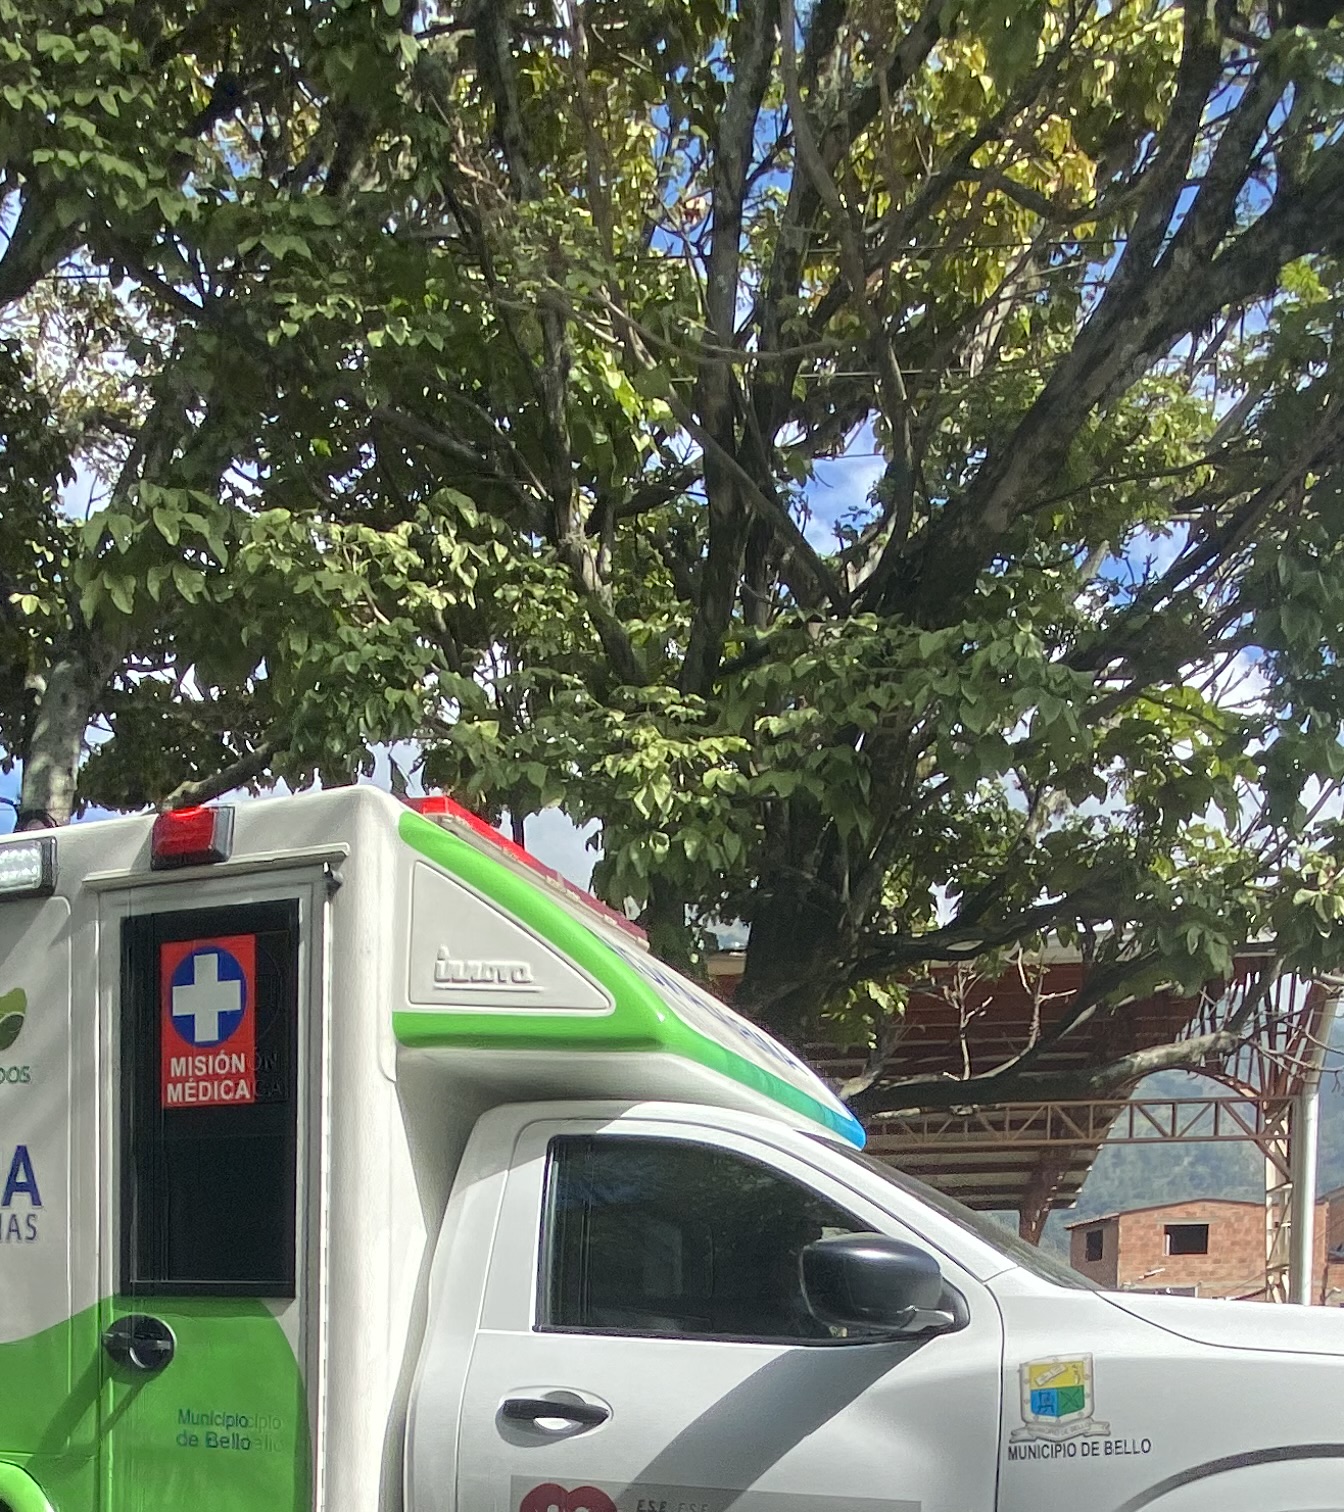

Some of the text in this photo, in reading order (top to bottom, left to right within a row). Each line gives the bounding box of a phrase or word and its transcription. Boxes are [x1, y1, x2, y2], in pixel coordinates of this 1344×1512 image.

[170, 1049, 246, 1077] MISIÓN
[167, 1078, 251, 1103] MÉDICA
[177, 1408, 249, 1431] Municipio
[176, 1430, 251, 1450] de Bello
[1008, 1437, 1152, 1461] MUNICIPIO DE BELLO
